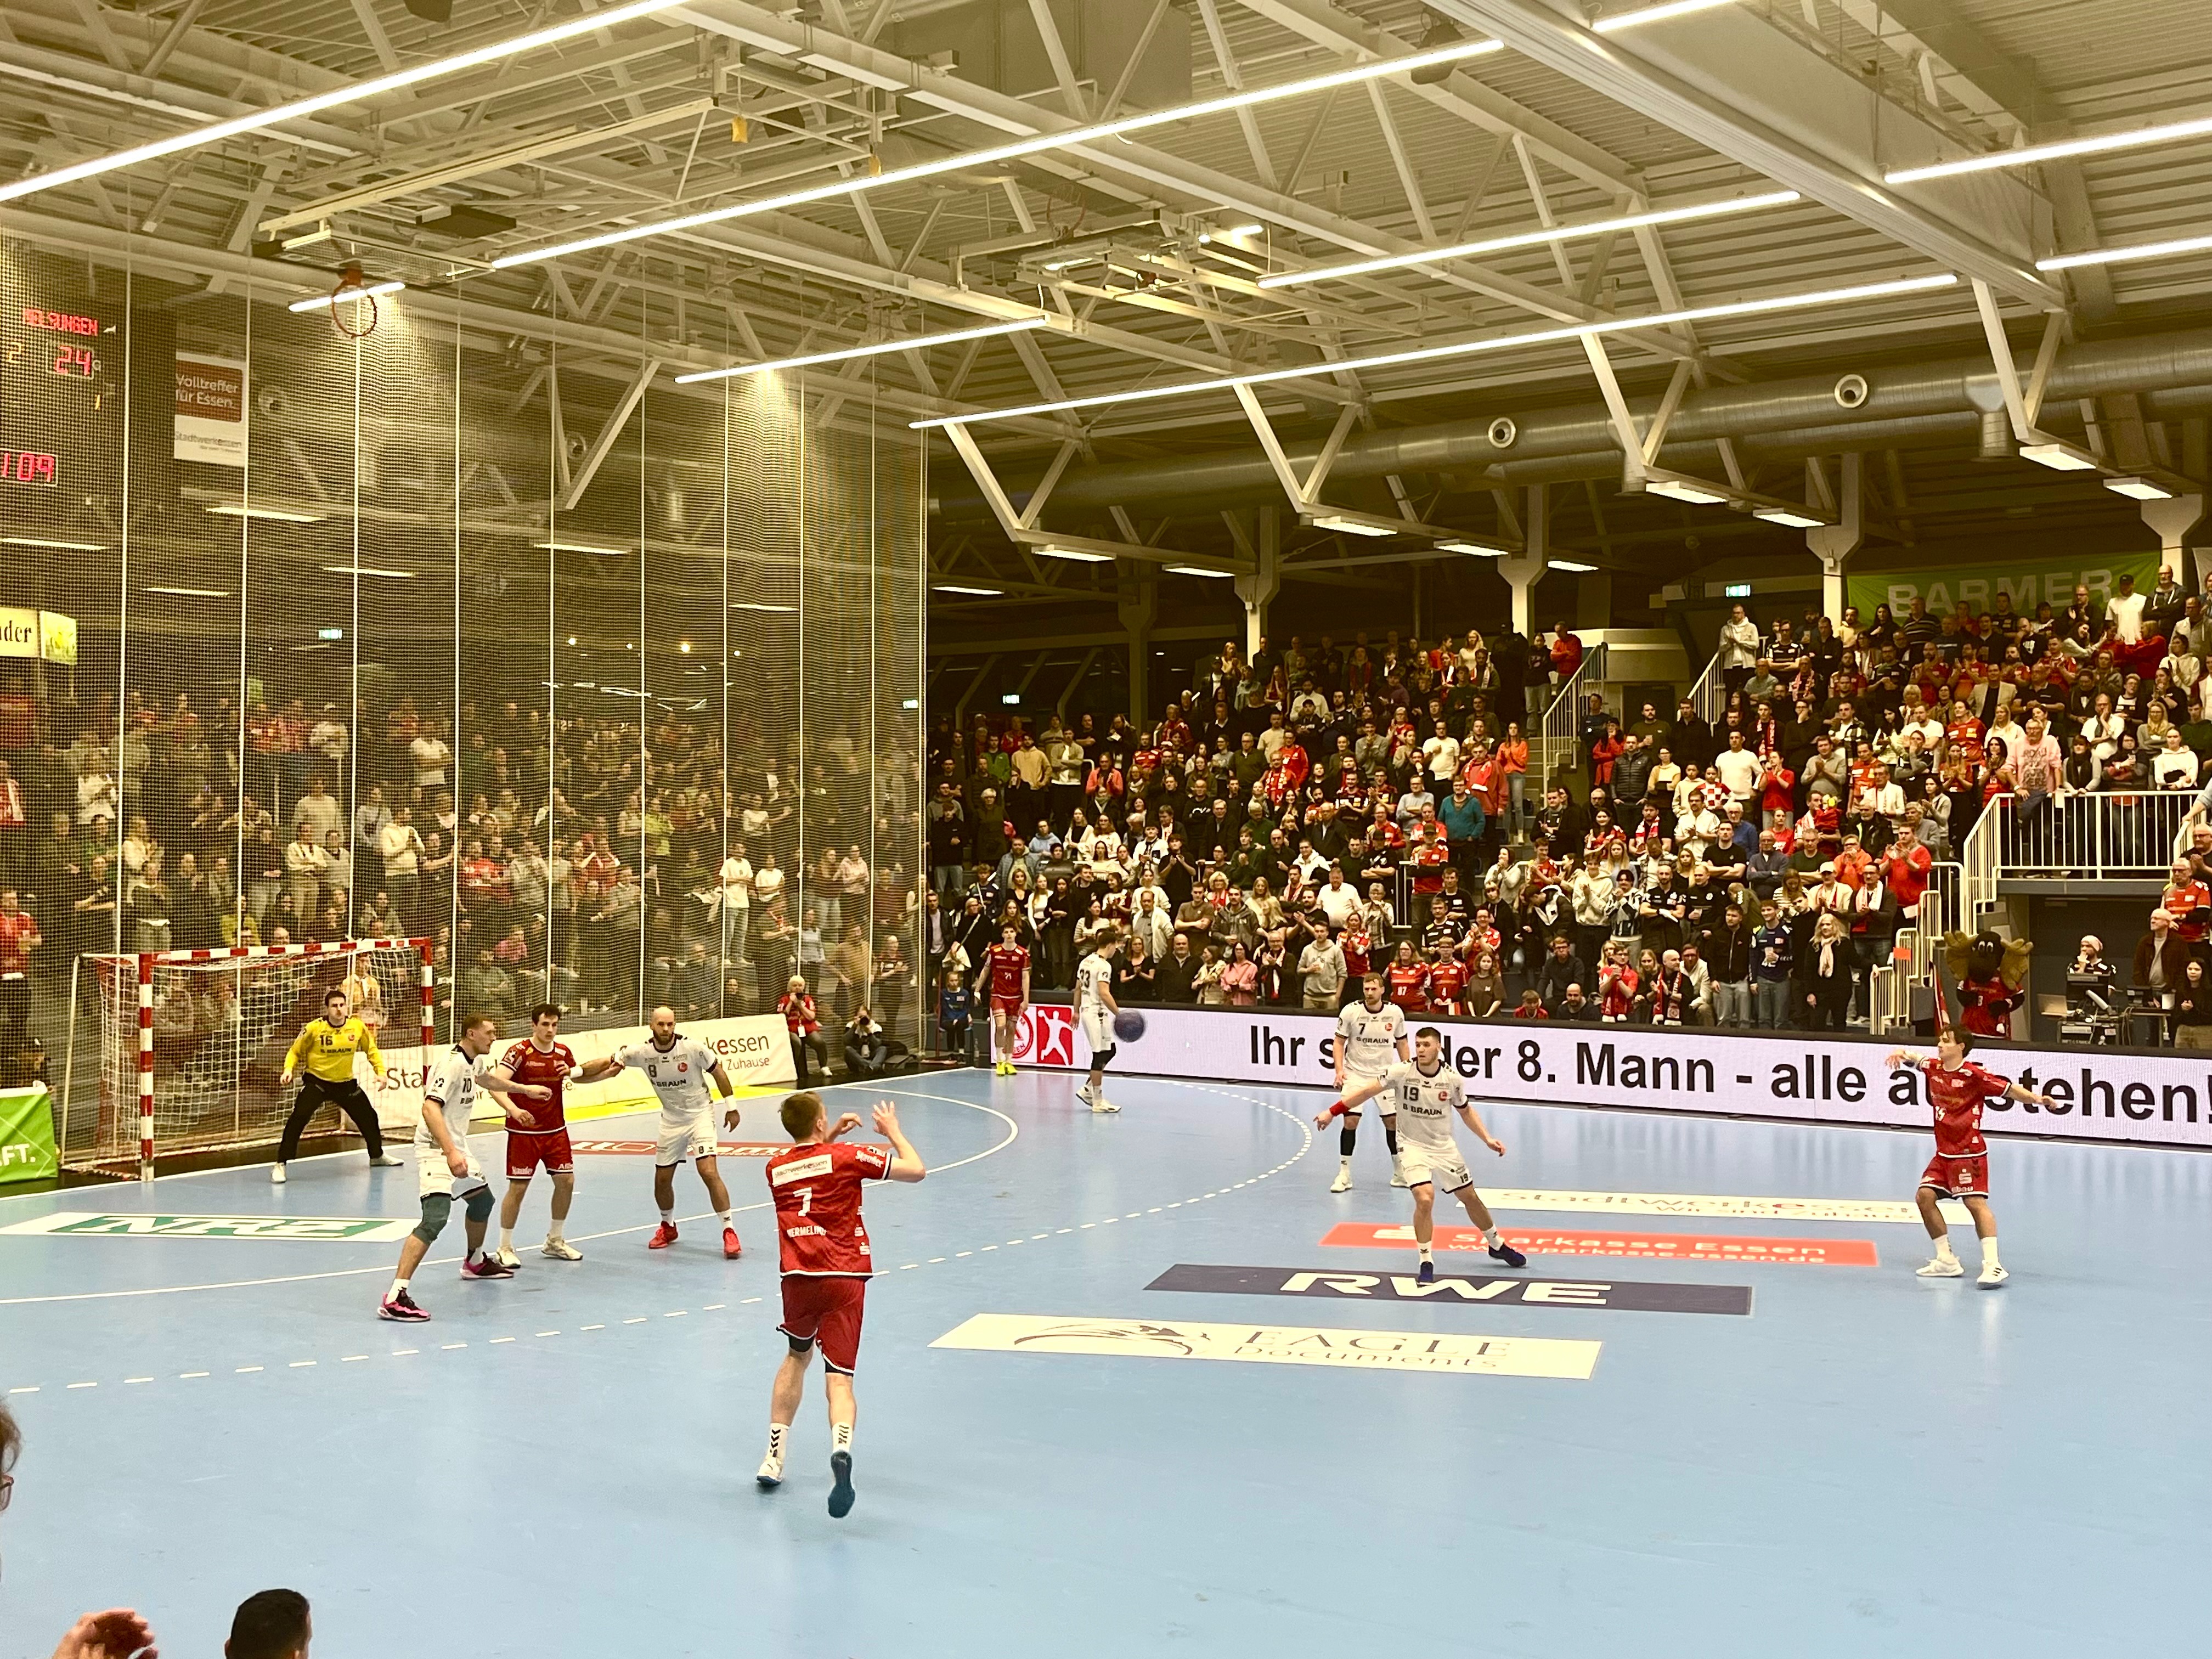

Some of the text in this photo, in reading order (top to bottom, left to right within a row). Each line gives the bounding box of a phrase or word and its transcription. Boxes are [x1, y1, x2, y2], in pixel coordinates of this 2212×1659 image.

[55, 346, 91, 376] 24
[1888, 569, 2113, 617] BARMER
[1358, 1023, 1366, 1035] 7
[319, 1035, 333, 1046] 16
[648, 1064, 657, 1077] 8
[1250, 1025, 1306, 1066] Ihr
[1517, 1040, 1556, 1083] 8.
[1576, 1042, 1714, 1093] Mann
[1771, 1054, 1867, 1103] alle
[1403, 1085, 1420, 1101] 19
[1411, 1105, 1443, 1115] BRAUN
[0, 1143, 36, 1166] FT.
[1460, 1173, 1469, 1183] 19
[793, 1187, 812, 1217] 7
[71, 1216, 366, 1236] NRZ
[1451, 1234, 1825, 1255] Sparkasse Essen
[1280, 1272, 1612, 1305] RWE
[1246, 1331, 1511, 1358] EAGLE
[1233, 1346, 1497, 1368] Documents
